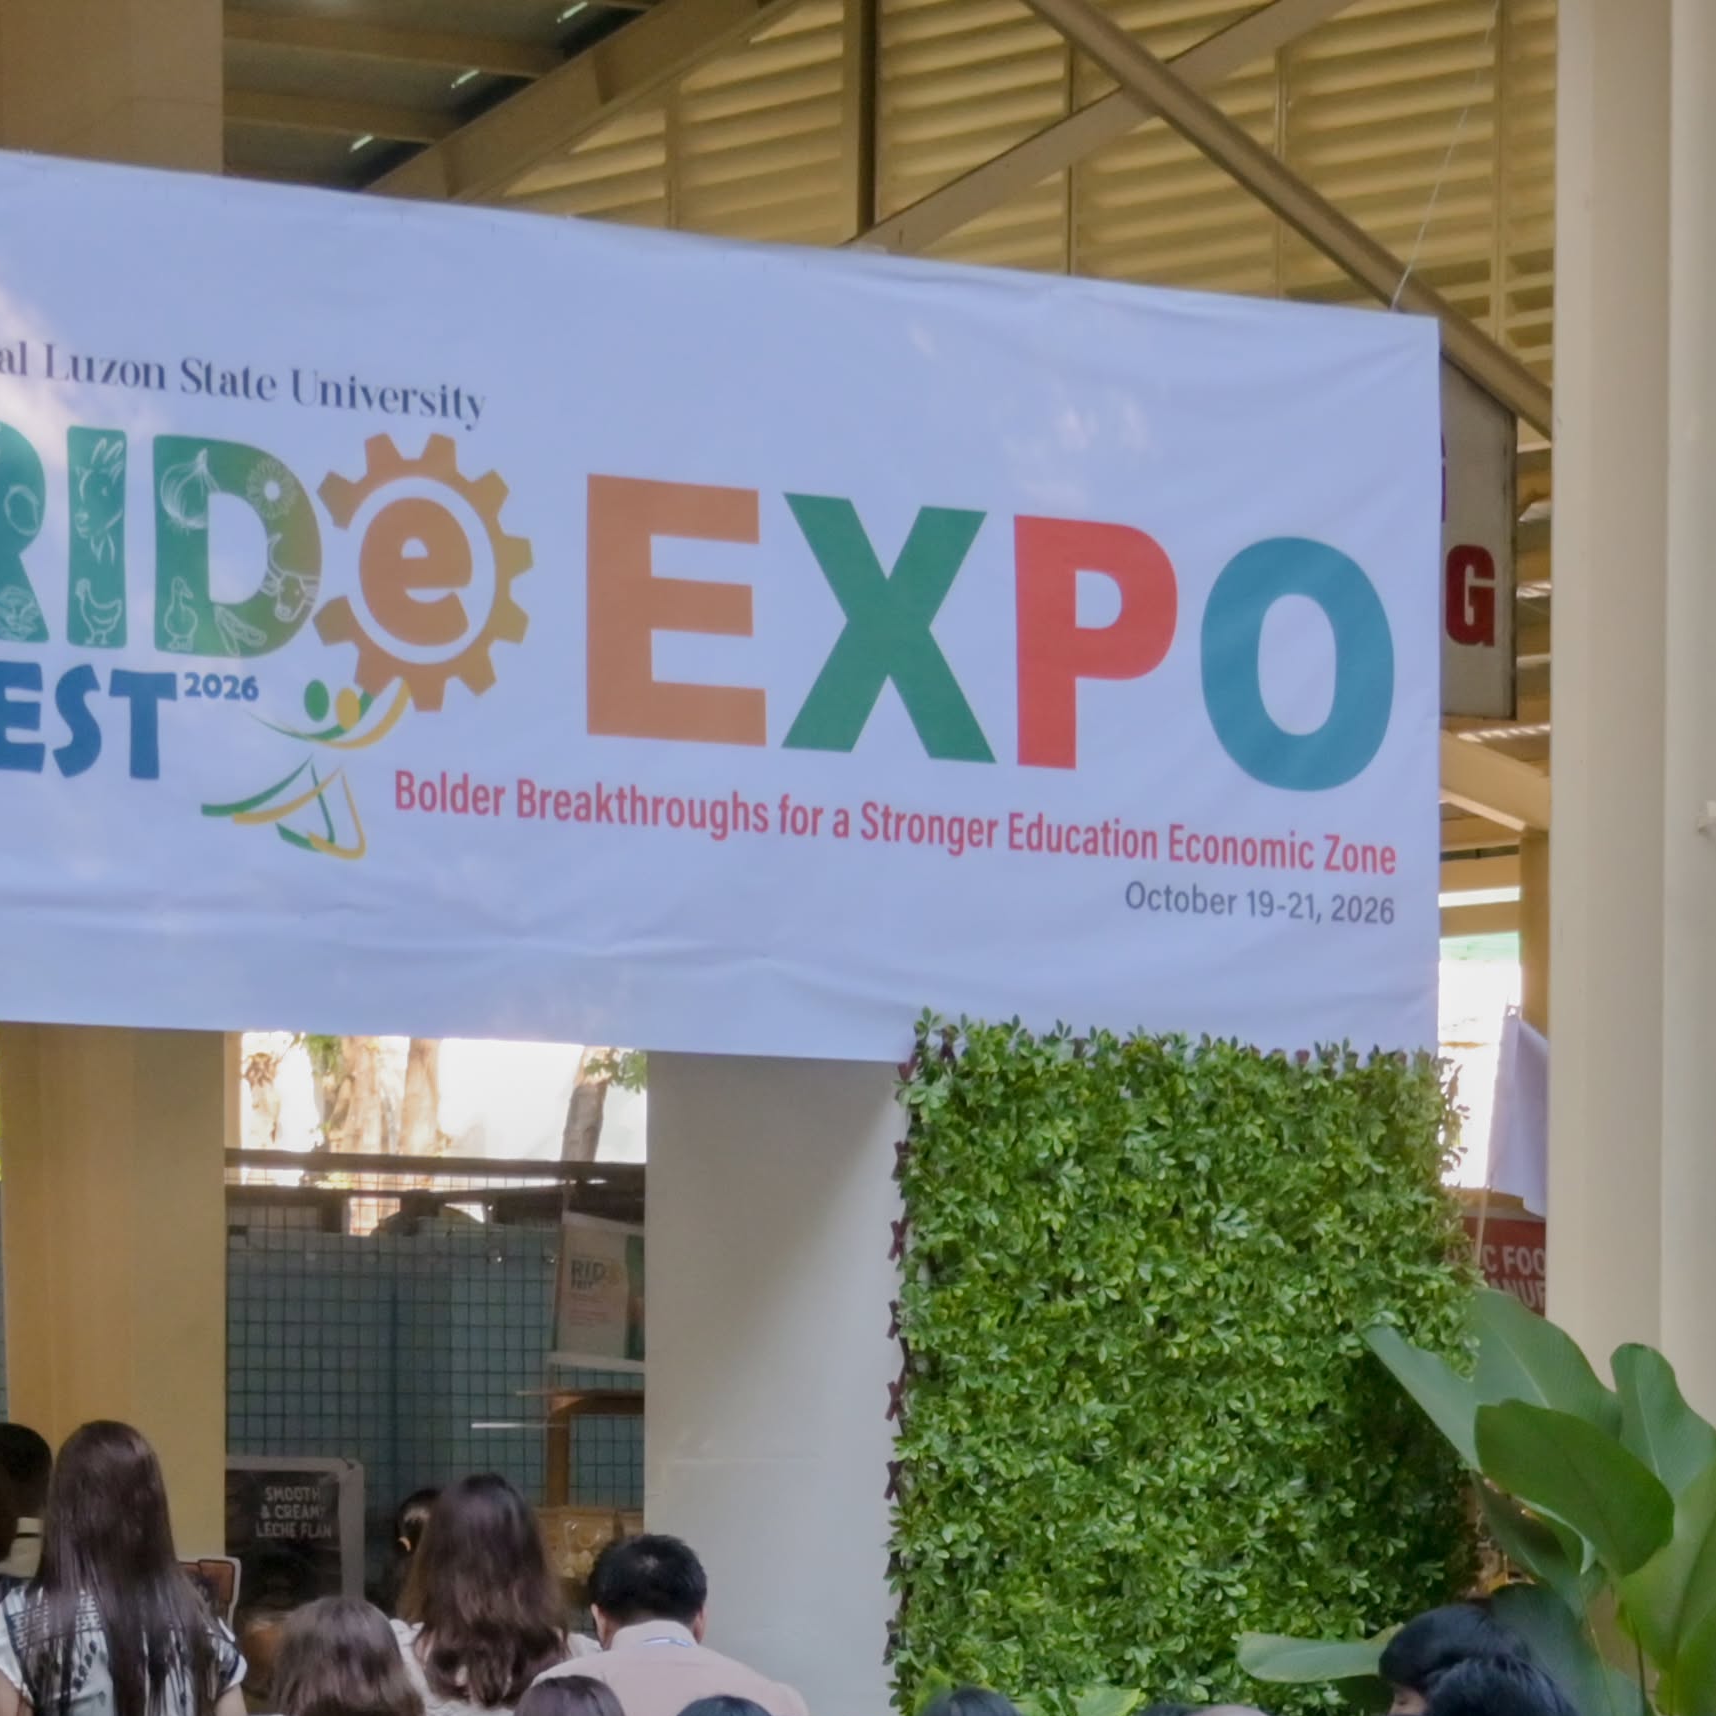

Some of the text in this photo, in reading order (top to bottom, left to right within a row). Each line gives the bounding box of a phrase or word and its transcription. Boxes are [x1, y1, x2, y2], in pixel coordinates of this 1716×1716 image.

[44, 342, 167, 391] Luzon
[180, 357, 278, 402] State
[292, 368, 486, 431] University
[585, 473, 1395, 791] EXPO
[184, 670, 260, 702] 2026
[394, 769, 1397, 875] Bolder Breakthroughs for a Stronger Education Economic Zone
[1125, 881, 1395, 925] October 19-21, 2026
